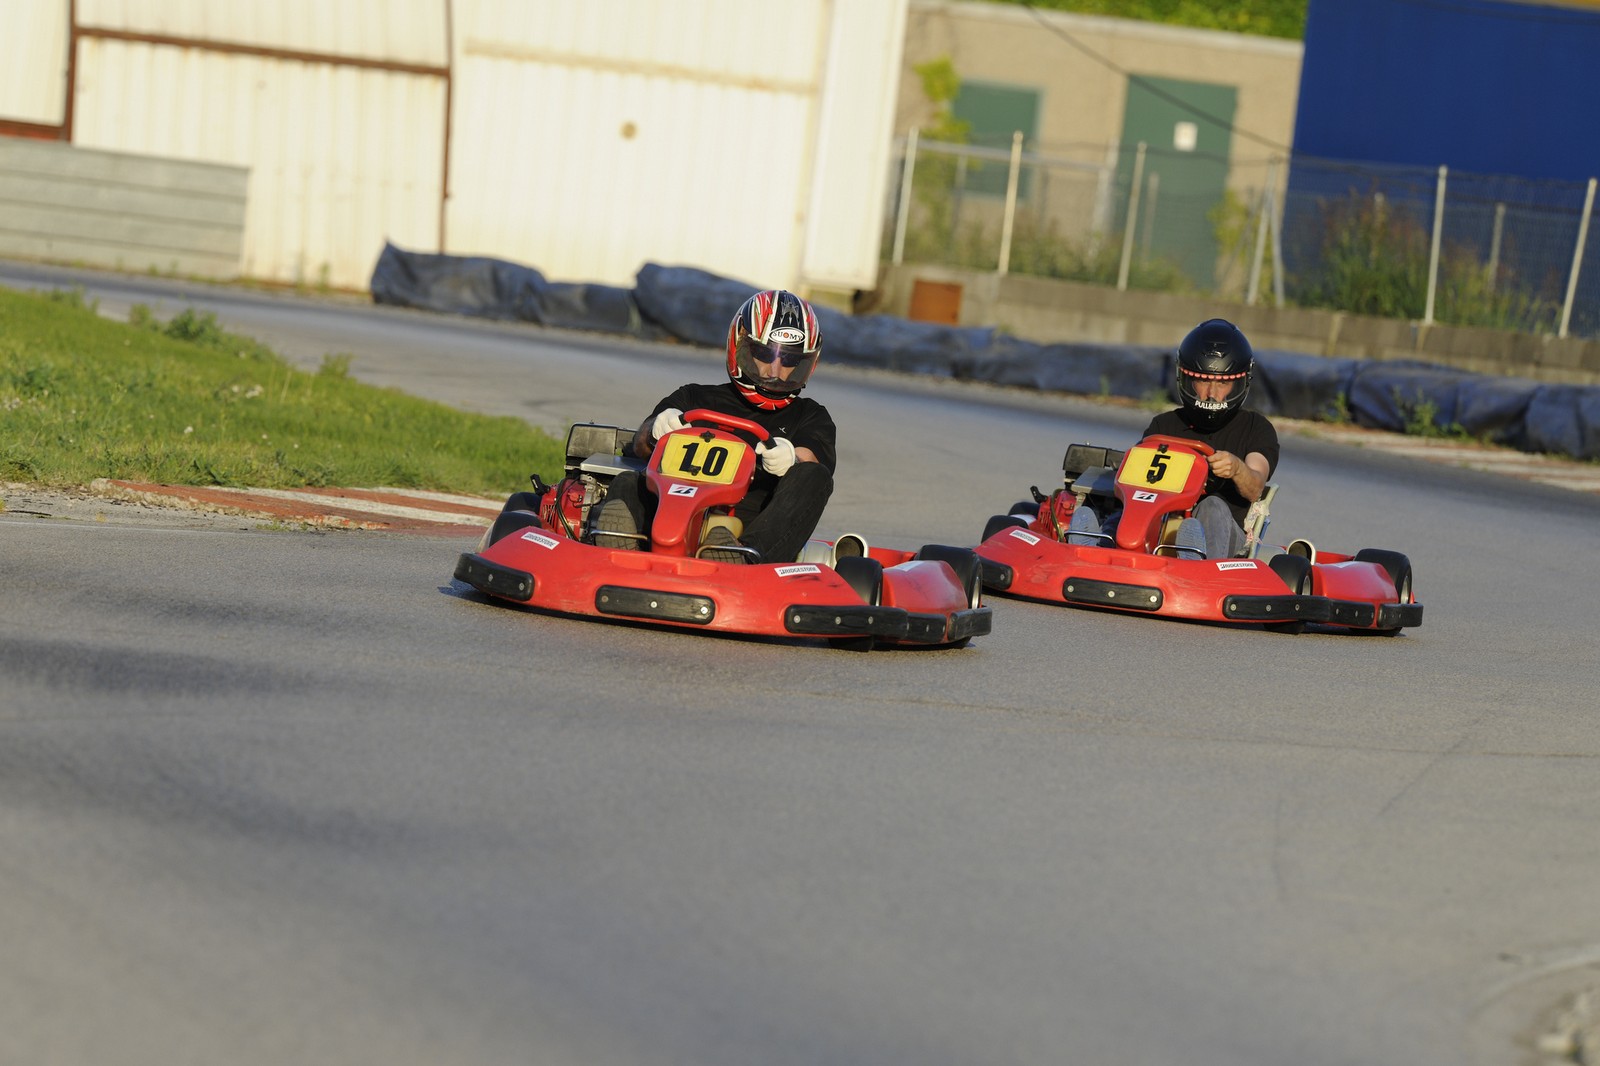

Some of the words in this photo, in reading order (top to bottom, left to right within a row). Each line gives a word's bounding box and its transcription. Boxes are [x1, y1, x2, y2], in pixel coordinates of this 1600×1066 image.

[1195, 400, 1228, 410] PULL&BEAR
[679, 442, 729, 476] 10
[1146, 454, 1171, 484] 5
[779, 566, 818, 575] BRIDGESTONE
